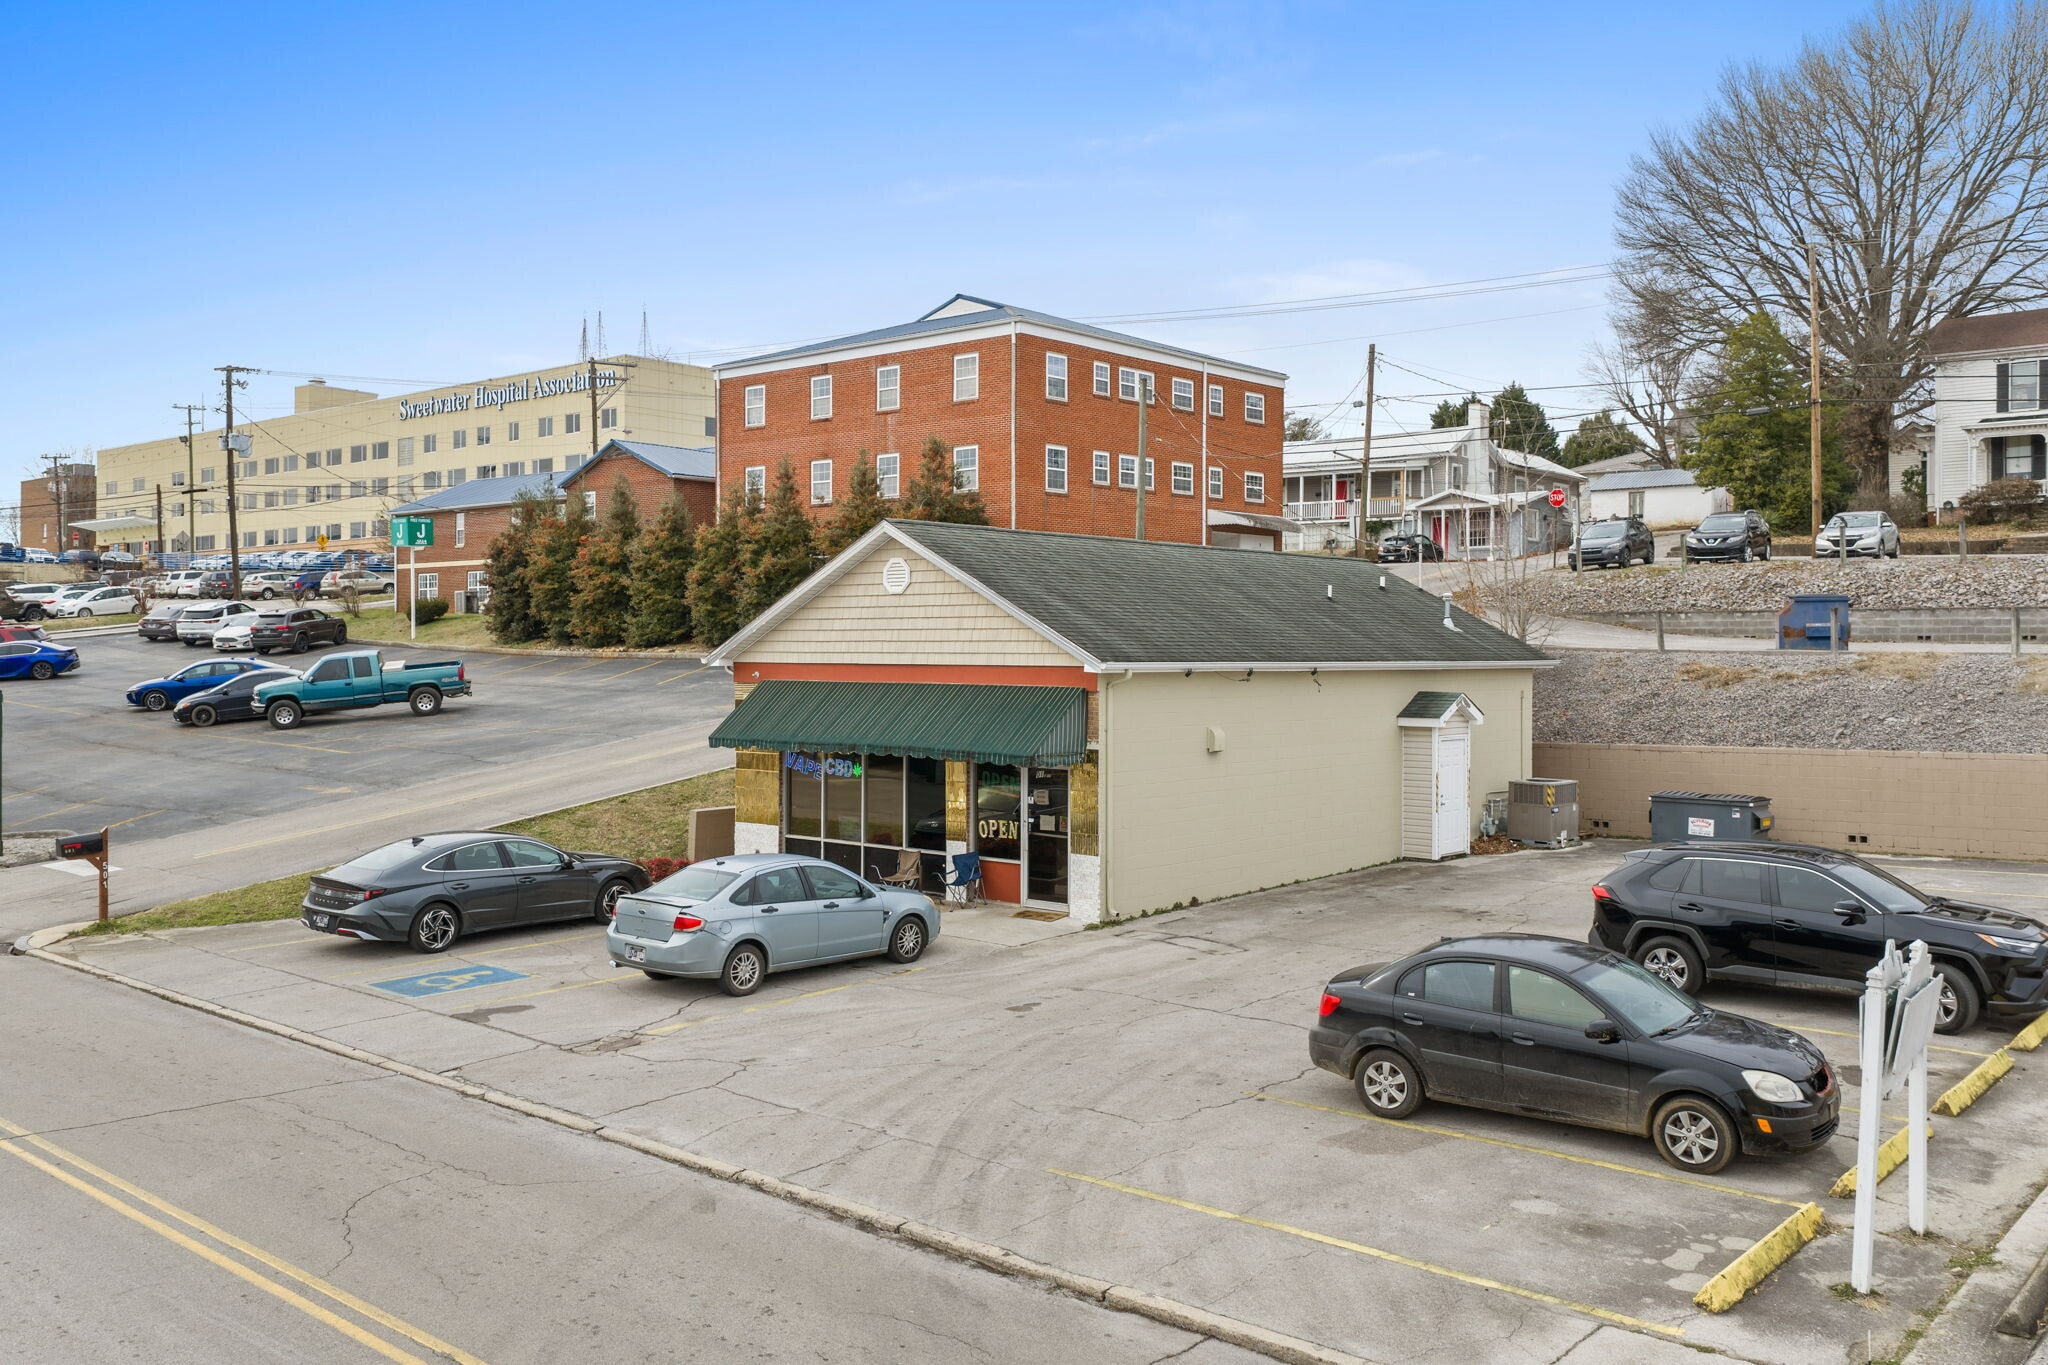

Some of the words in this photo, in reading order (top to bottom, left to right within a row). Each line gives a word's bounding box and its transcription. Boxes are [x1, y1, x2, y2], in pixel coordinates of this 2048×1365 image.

[399, 392, 470, 420] Sweetwater
[474, 379, 529, 411] Hospital
[532, 369, 616, 399] Associaton
[396, 523, 403, 539] J
[416, 523, 426, 539] J
[786, 751, 823, 780] VAPE
[825, 757, 853, 778] CBD
[979, 820, 1019, 839] OPEN
